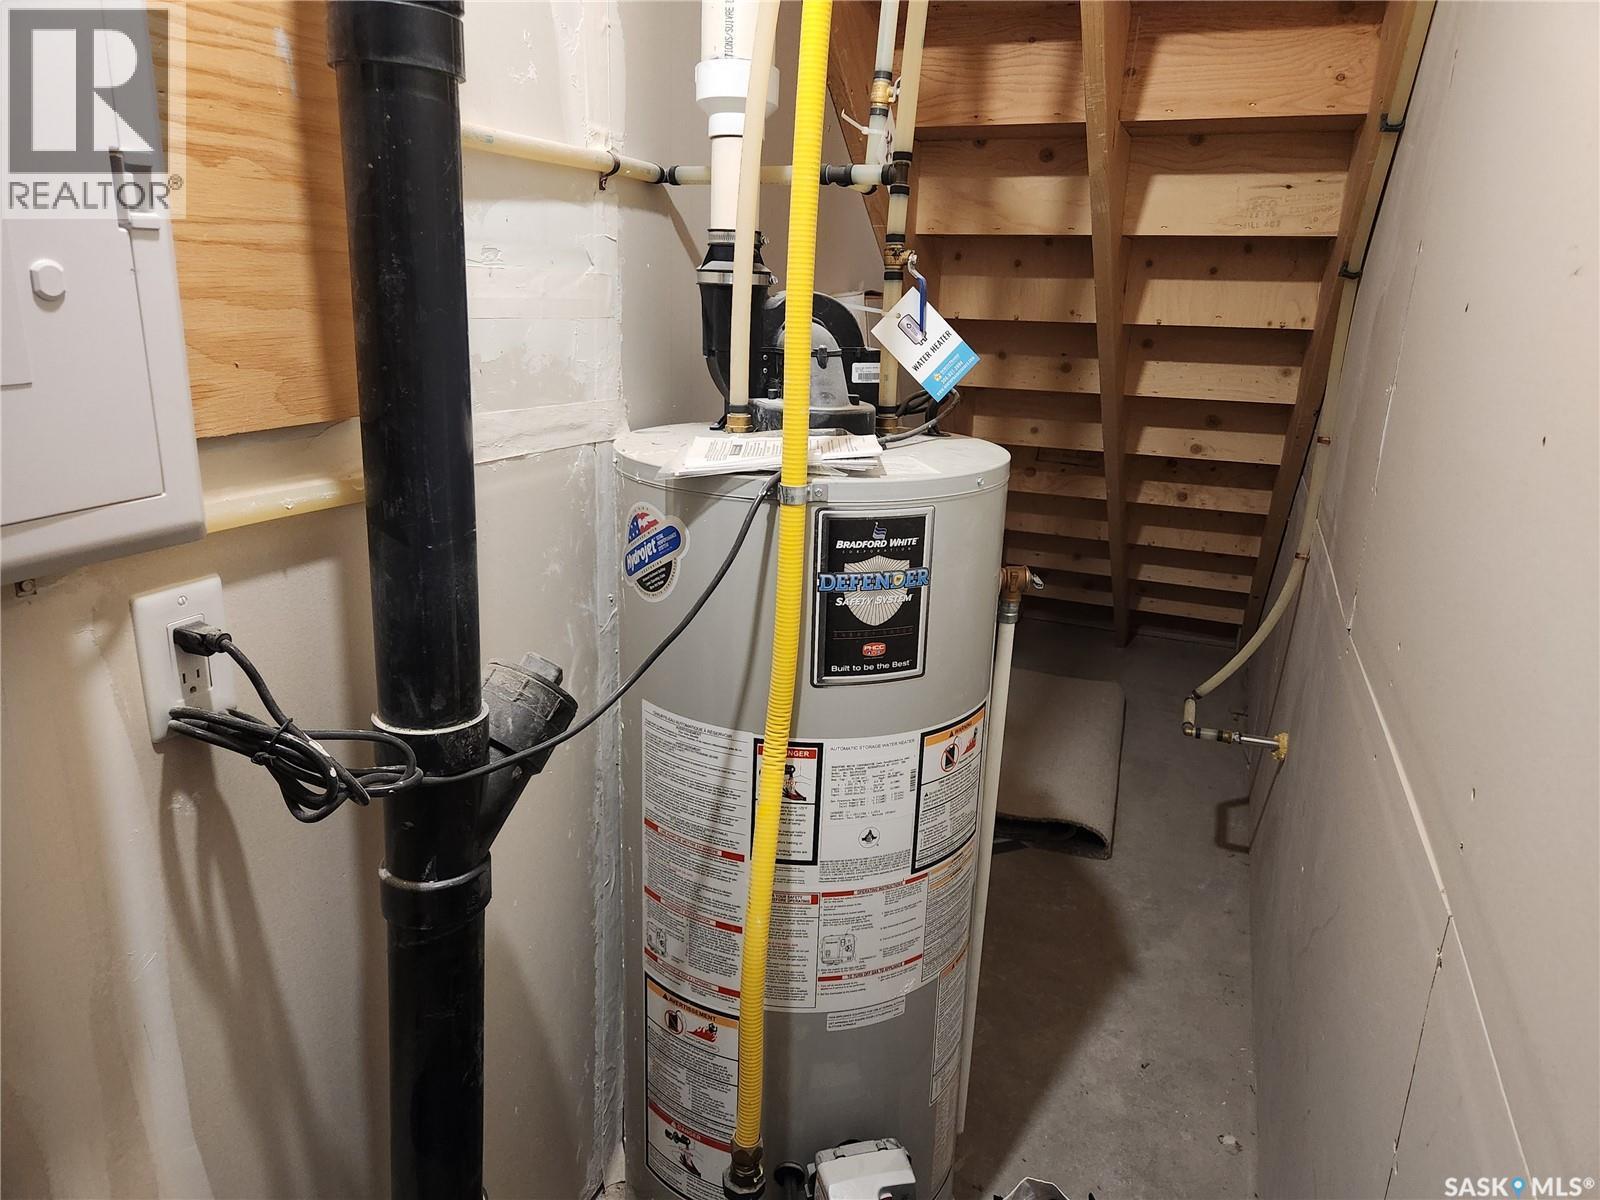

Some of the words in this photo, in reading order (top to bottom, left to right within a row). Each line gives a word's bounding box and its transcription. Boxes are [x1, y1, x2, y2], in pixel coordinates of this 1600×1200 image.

[912, 351, 933, 372] WATER
[930, 330, 952, 354] HEATER
[836, 539, 887, 549] BRADFORD
[626, 538, 657, 572] Hydrojet
[818, 568, 930, 592] DEFENDER
[835, 597, 872, 607] SAFETY
[875, 594, 912, 604] SYSTEM
[864, 663, 874, 671] be
